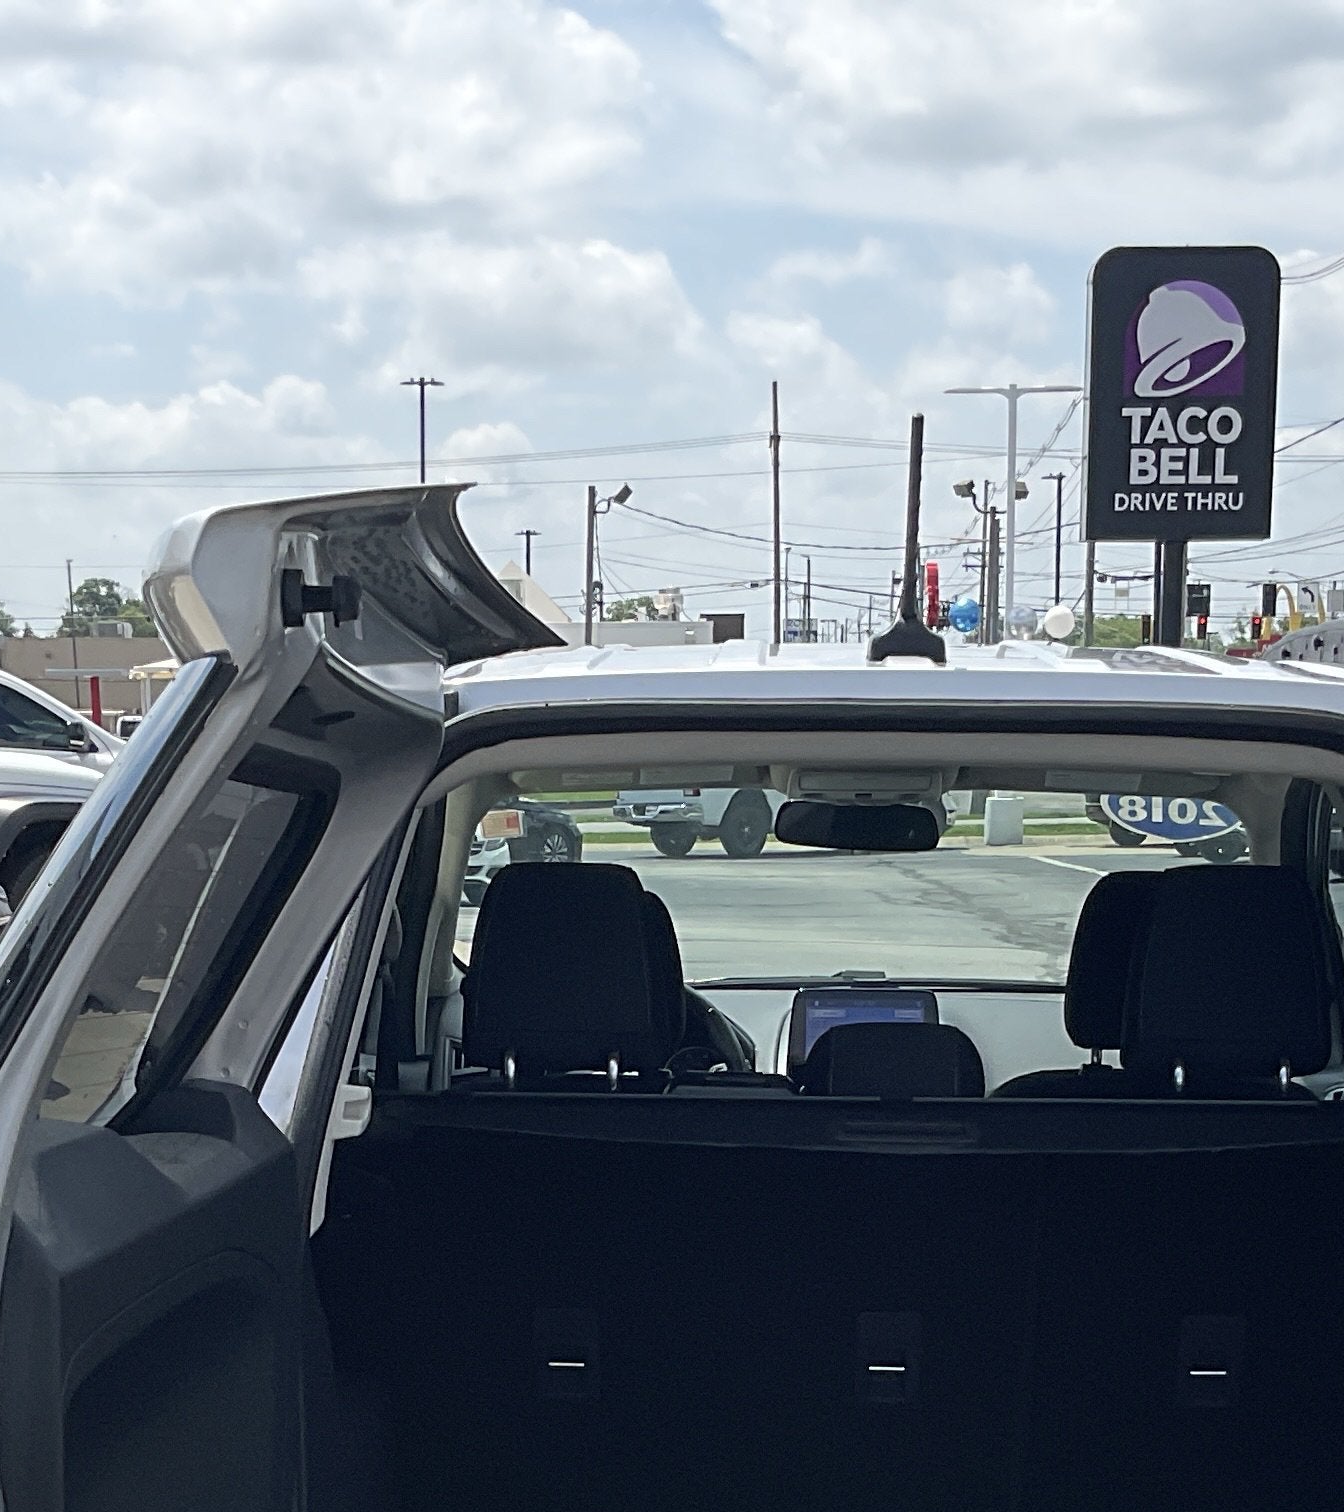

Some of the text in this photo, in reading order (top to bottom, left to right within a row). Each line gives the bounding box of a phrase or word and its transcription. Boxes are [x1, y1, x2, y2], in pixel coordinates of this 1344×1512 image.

[1121, 406, 1243, 444] TACO
[1128, 447, 1239, 486] BELL
[1113, 492, 1244, 512] DRIVE THRU
